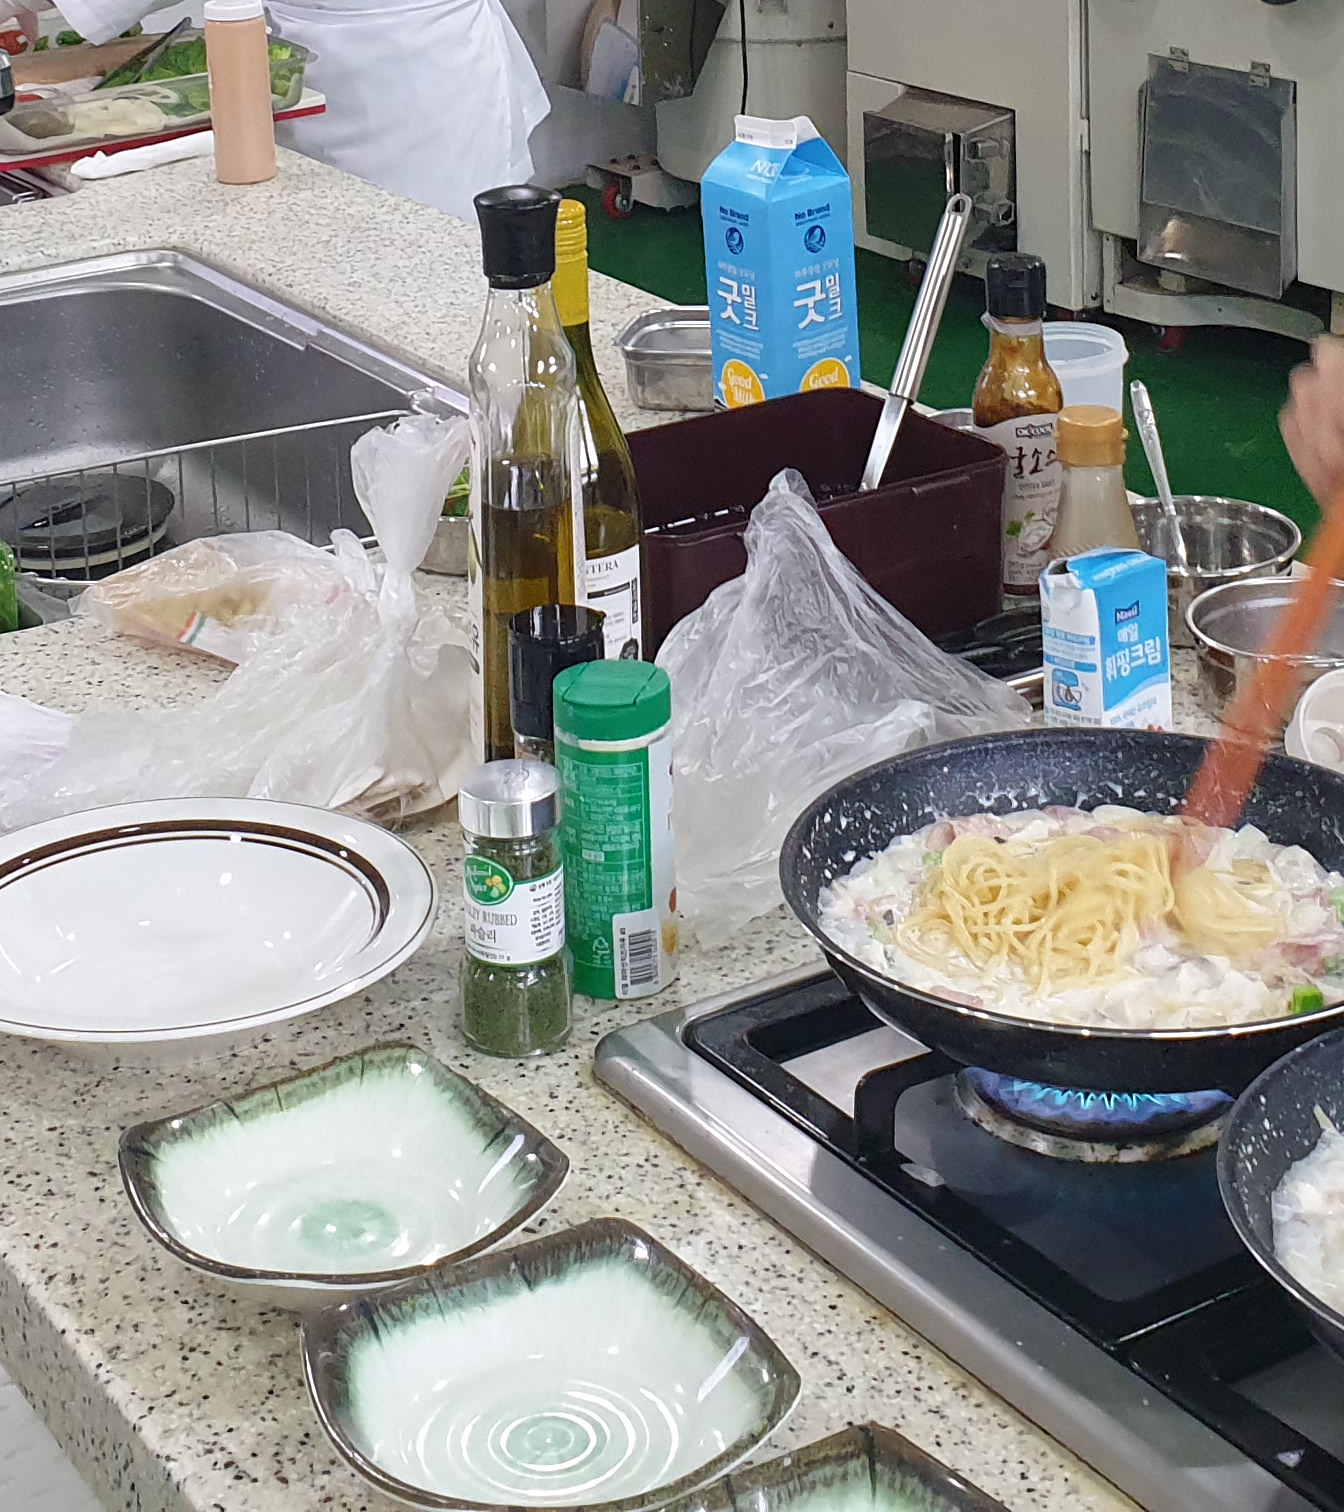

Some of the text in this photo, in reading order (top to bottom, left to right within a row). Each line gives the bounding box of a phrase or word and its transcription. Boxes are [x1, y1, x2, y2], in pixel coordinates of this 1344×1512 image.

[717, 276, 760, 331] 굿 밀크
[793, 271, 844, 330] 굿 밀크
[1118, 622, 1139, 643] 매일
[1105, 635, 1162, 682] 휘핑크림
[483, 910, 518, 927] RUBBED
